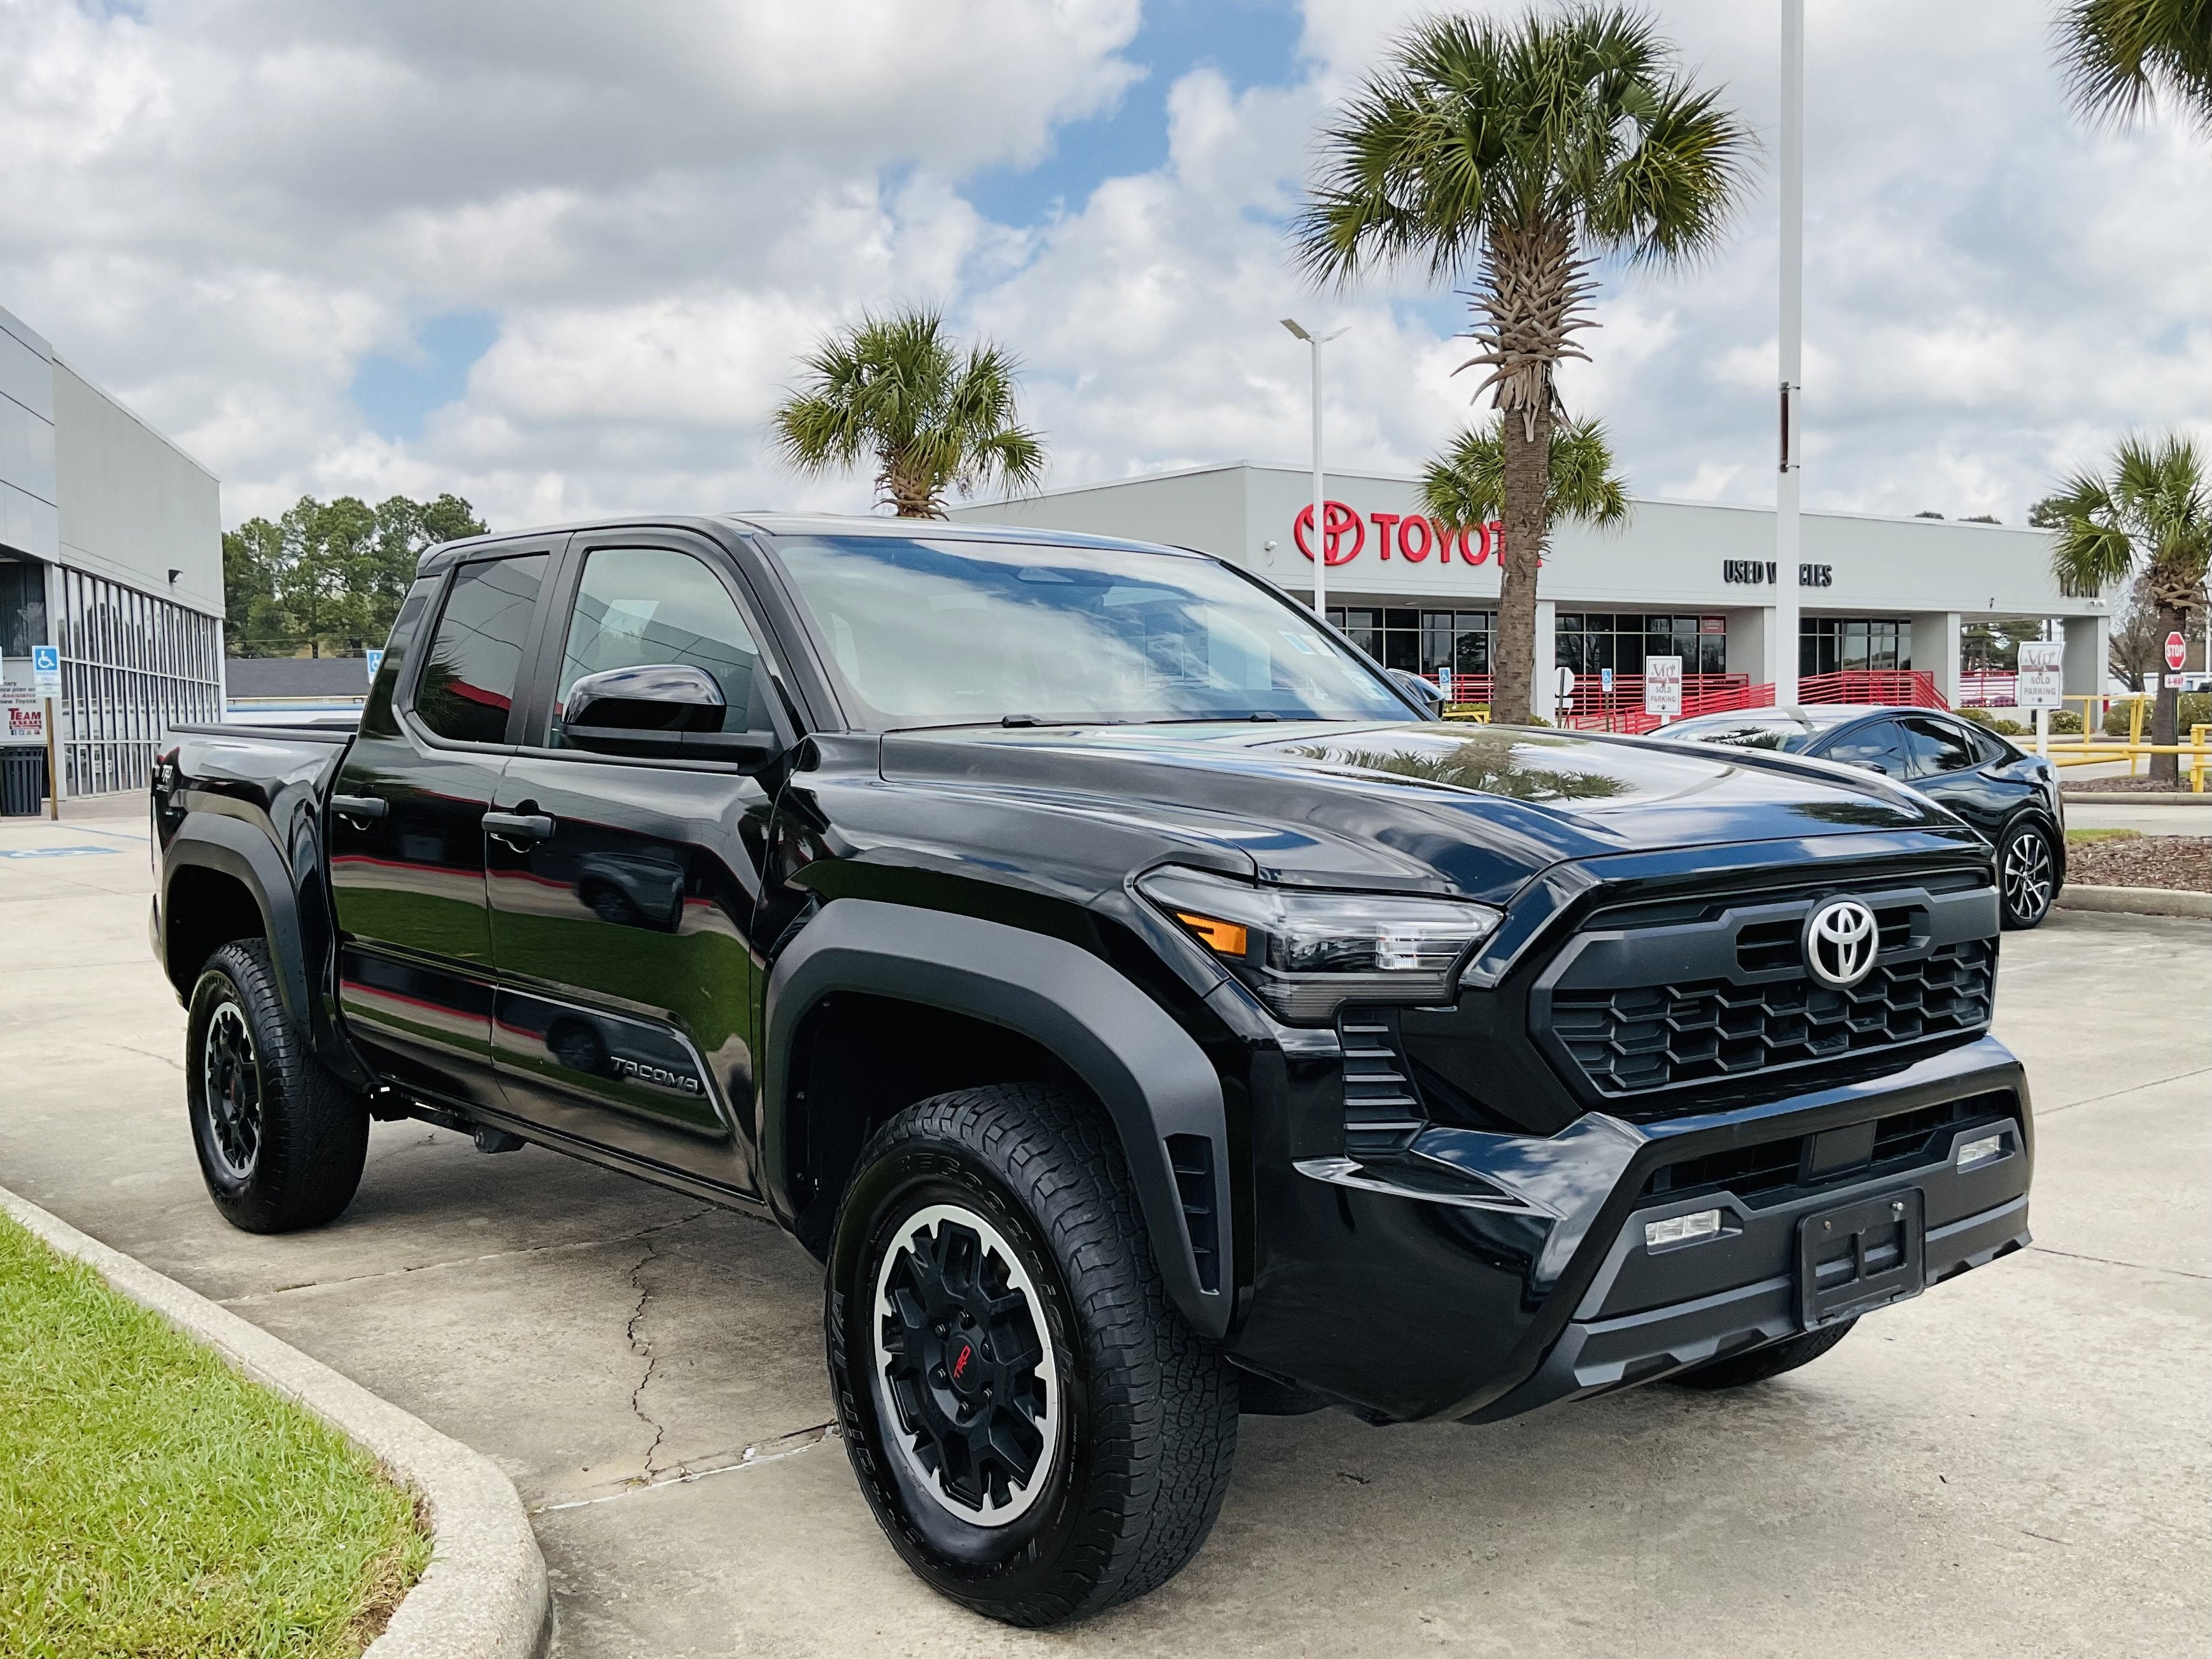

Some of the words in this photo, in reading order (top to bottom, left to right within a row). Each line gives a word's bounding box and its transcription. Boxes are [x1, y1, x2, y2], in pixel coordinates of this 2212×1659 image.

[1370, 512, 1542, 567] TOYOT
[1723, 560, 1765, 584] USED
[1766, 561, 1833, 587] VCLES
[2167, 644, 2184, 658] STOP
[2167, 676, 2184, 686] 4-WAY
[8, 707, 41, 721] TEAM
[610, 1056, 699, 1093] TACOMA
[954, 1345, 971, 1380] TRD
